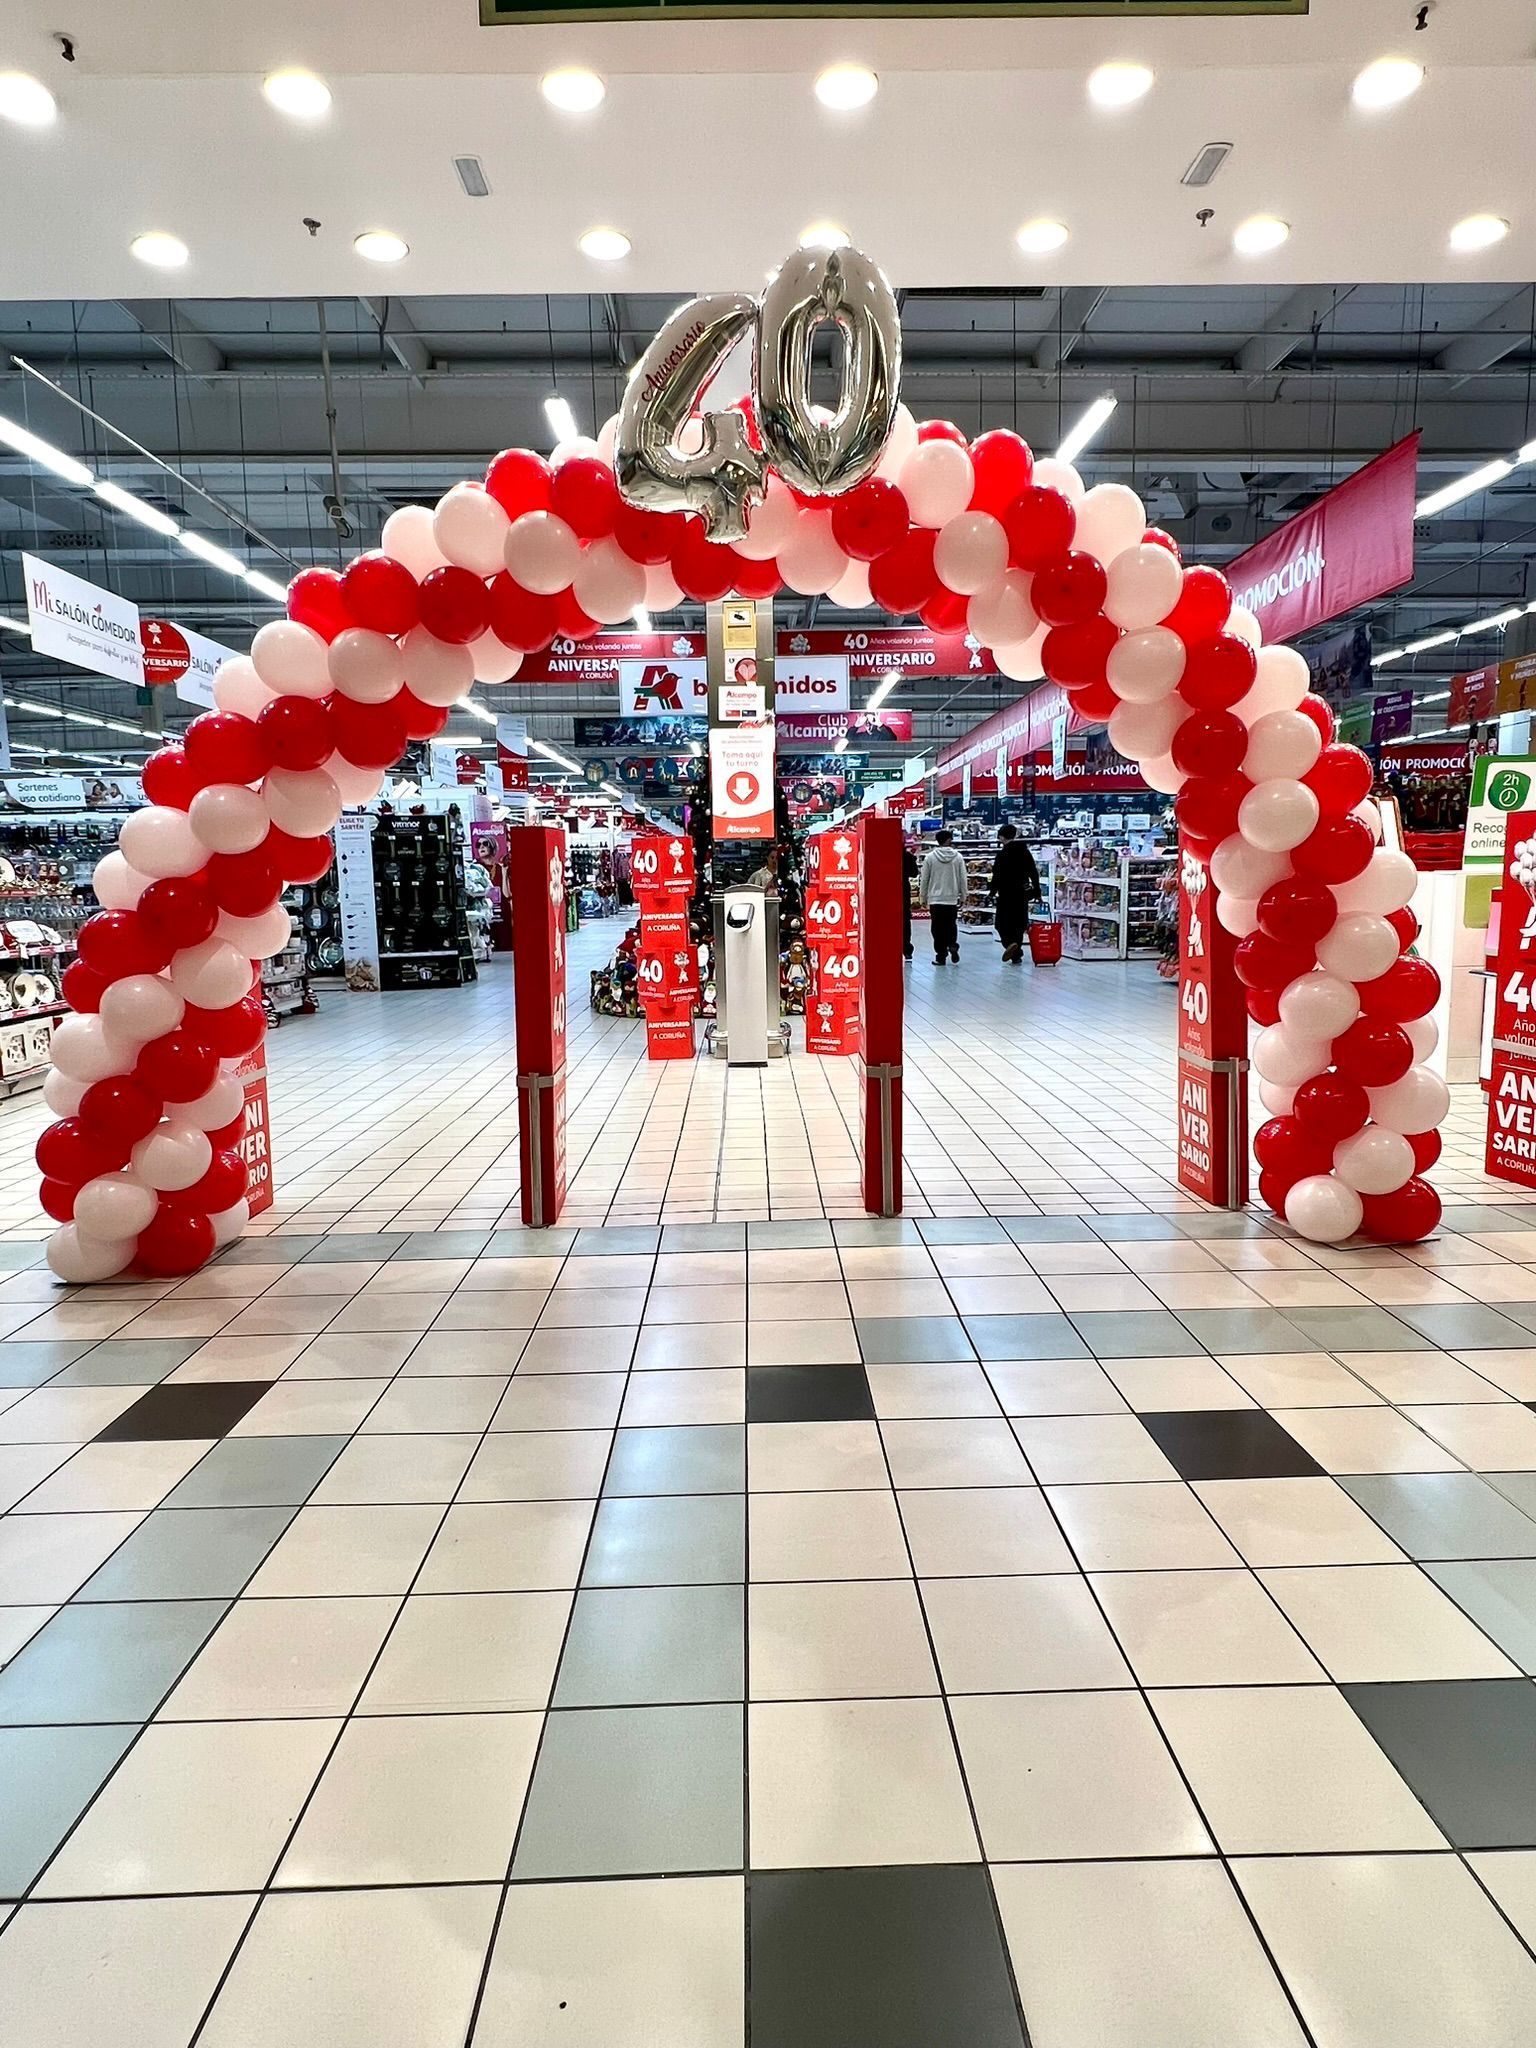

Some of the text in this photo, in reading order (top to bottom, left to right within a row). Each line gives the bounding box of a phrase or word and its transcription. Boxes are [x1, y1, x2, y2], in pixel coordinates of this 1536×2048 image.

[641, 321, 706, 402] Aniversario
[614, 246, 902, 545] 40
[55, 599, 91, 627] SALÓN
[91, 614, 137, 645] COMEDOR
[550, 639, 576, 655] 40
[844, 633, 935, 649] 40 Años volando juntos
[548, 659, 620, 672] ANIVERSA
[877, 665, 905, 675] CORUÑA
[585, 671, 614, 680] CORUÑA
[726, 690, 757, 699] Alcampo
[817, 714, 849, 727] Club
[776, 721, 849, 740] Alcampo
[722, 751, 743, 759] Toma
[1095, 764, 1139, 776] ROMO
[17, 782, 58, 792] Sartenes
[1502, 773, 1520, 786] 2h
[19, 792, 82, 803] uso cotidiano
[633, 849, 658, 874] 40
[807, 899, 842, 925] 40
[653, 923, 681, 931] CORUÑA
[639, 959, 663, 983] 40
[823, 954, 860, 979] 40
[1182, 979, 1208, 1025] 40
[648, 1021, 691, 1029] ANIVERSARIO
[658, 1031, 687, 1040] CORUÑA
[1504, 1032, 1536, 1047] volan
[1181, 1079, 1208, 1116] ANI
[1495, 1099, 1536, 1136] VE
[1181, 1107, 1210, 1149] VER
[1492, 1131, 1536, 1160] SARI
[1181, 1139, 1210, 1172] SARIO
[1496, 1156, 1536, 1175] A CORUÑ
